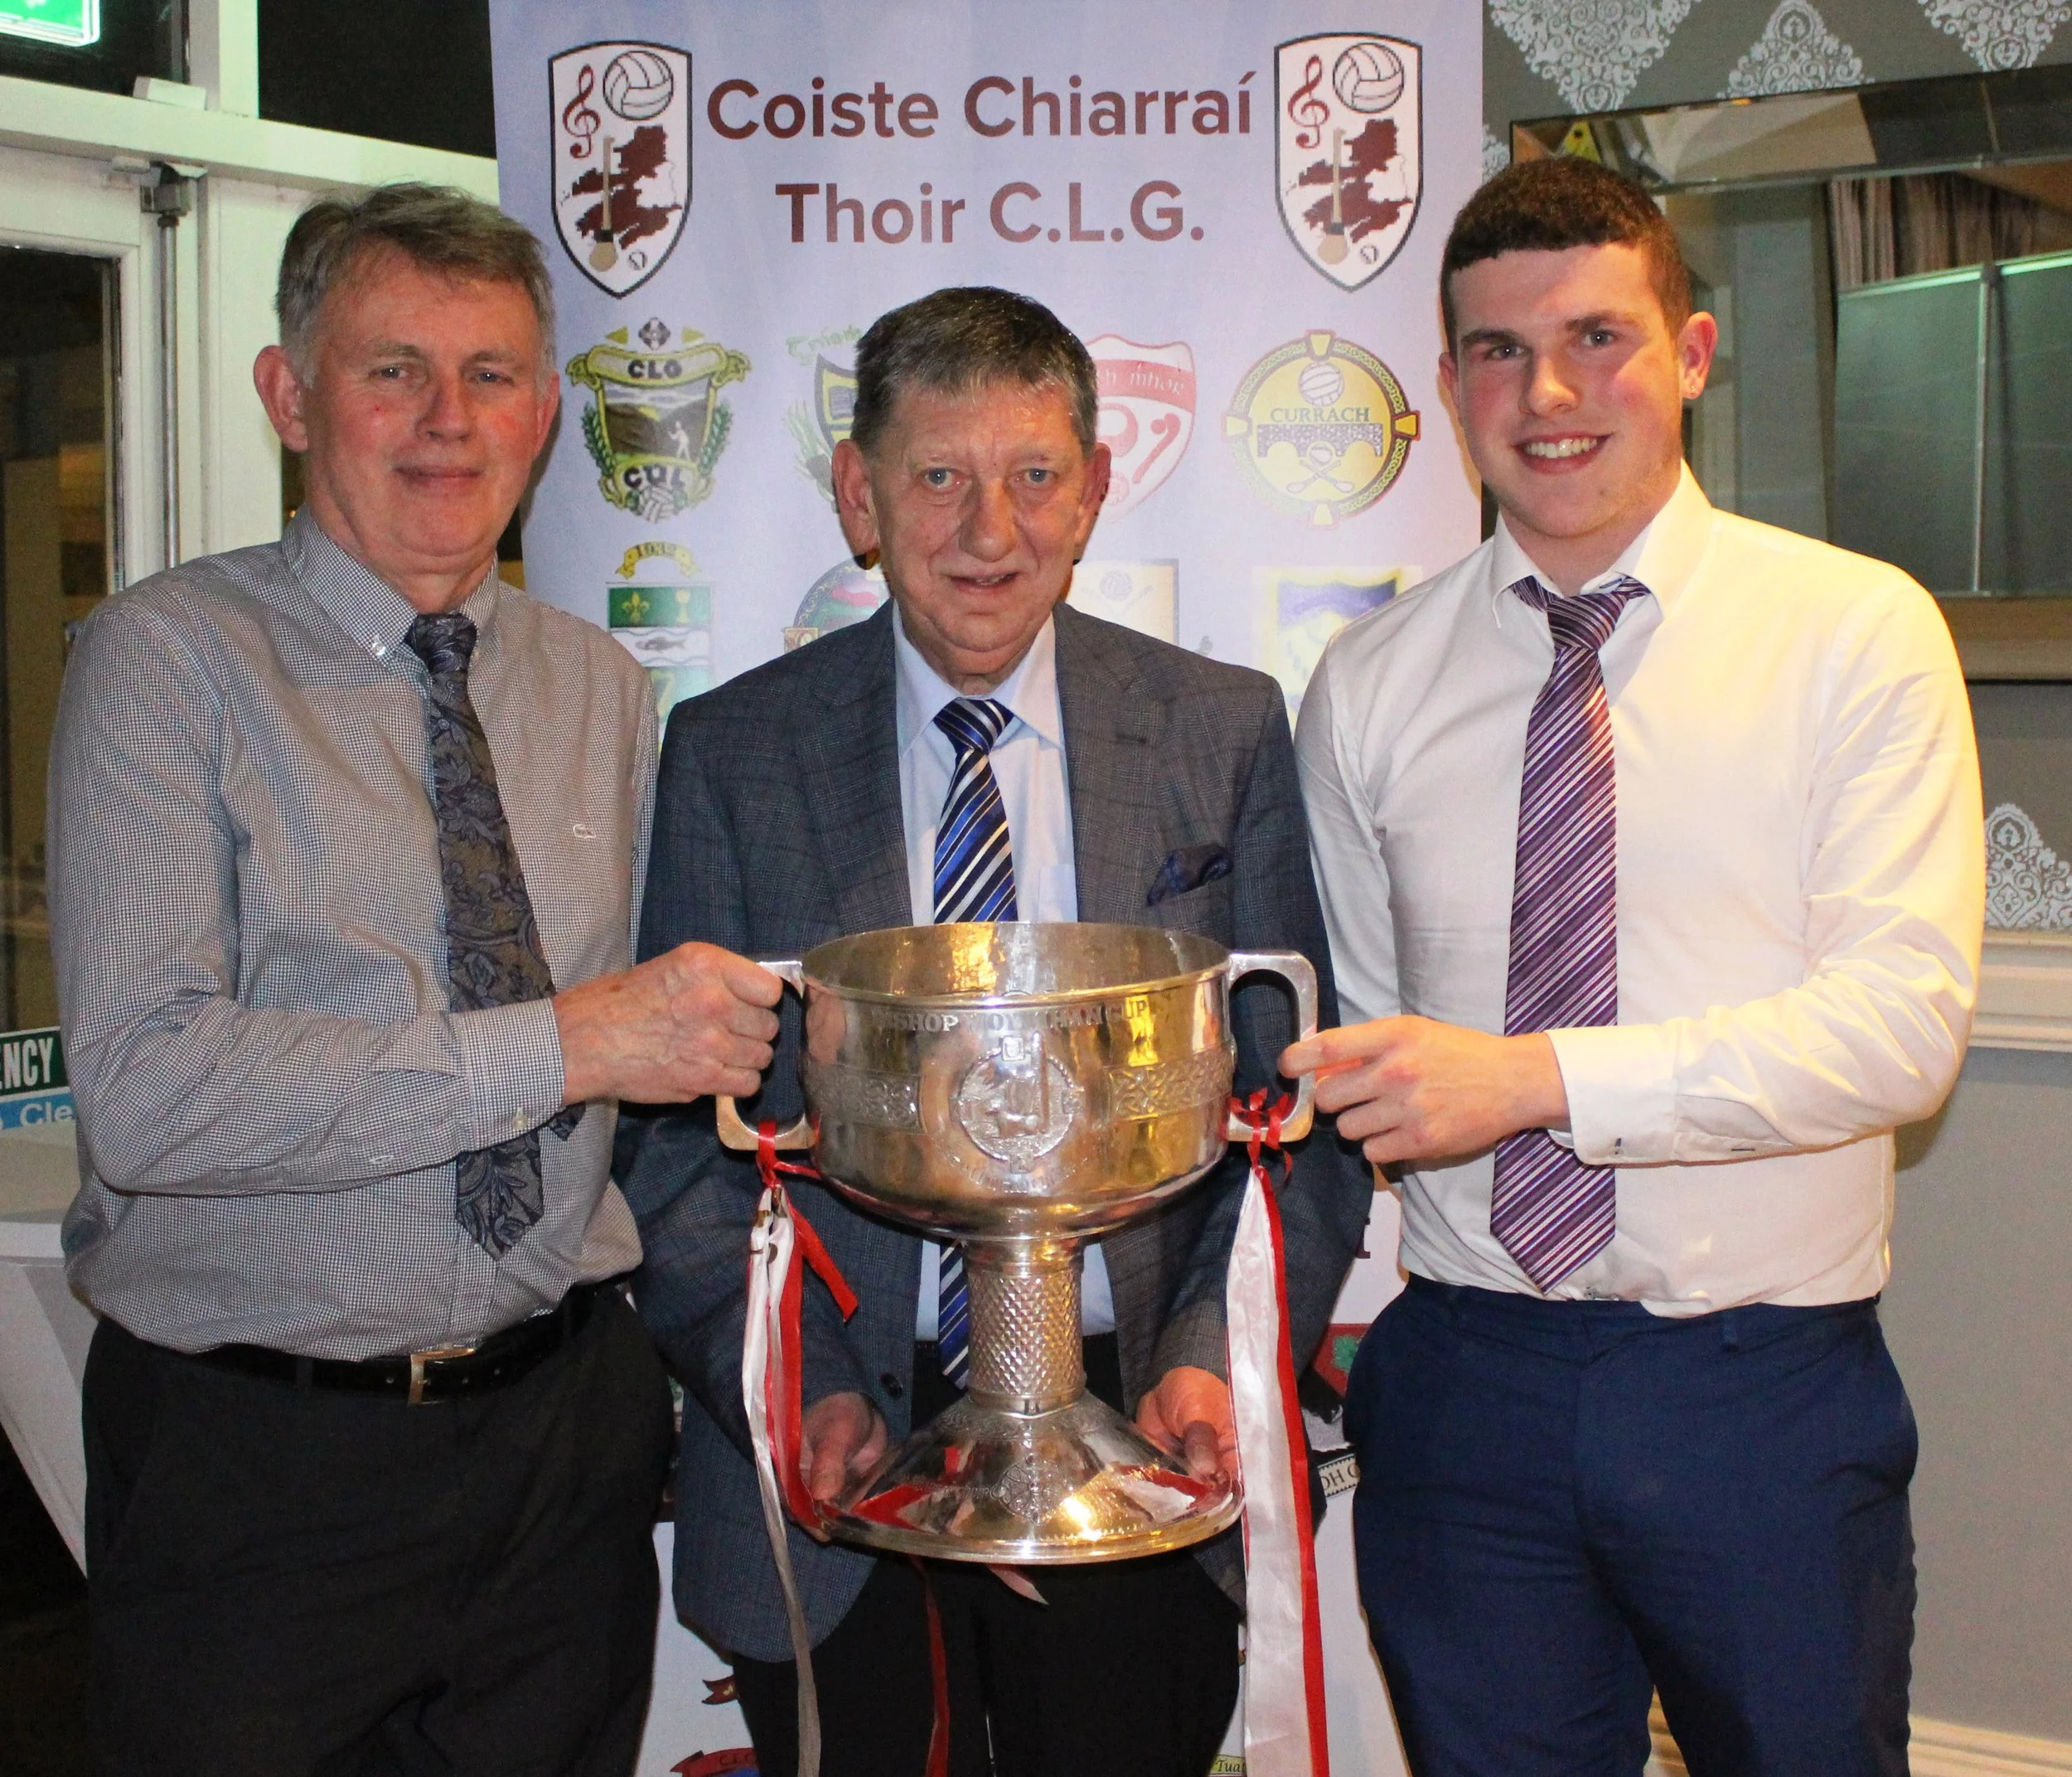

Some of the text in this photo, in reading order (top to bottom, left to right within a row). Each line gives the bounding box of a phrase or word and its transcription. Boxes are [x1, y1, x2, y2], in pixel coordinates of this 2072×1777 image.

[707, 70, 1256, 141] Coiste Chiarraí
[774, 179, 1205, 245] Thoir C.L.G.
[1269, 407, 1370, 424] CURRACH
[873, 1009, 960, 1033] SHOP
[0, 1037, 53, 1090] NCY
